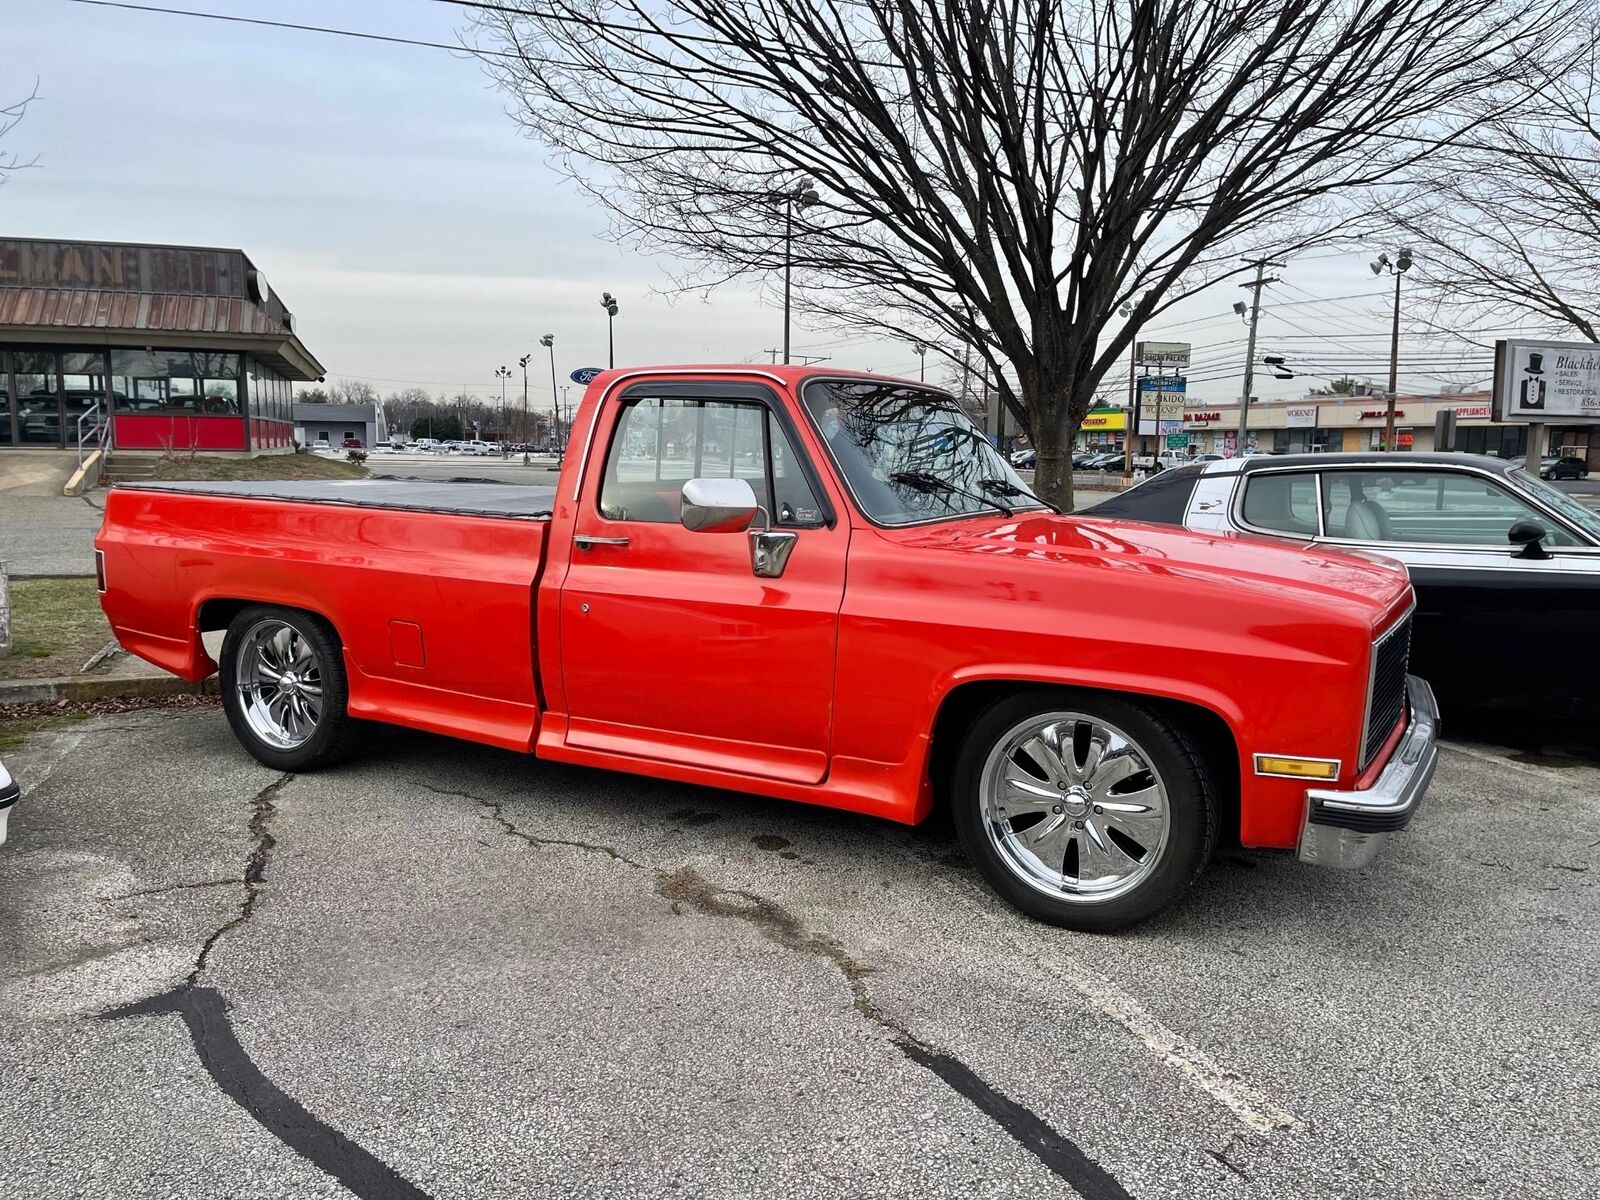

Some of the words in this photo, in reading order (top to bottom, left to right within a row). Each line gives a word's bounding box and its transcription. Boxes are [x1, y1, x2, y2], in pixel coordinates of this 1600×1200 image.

[1165, 354, 1188, 362] PALACE
[1557, 388, 1597, 396] RESTORATION
[1154, 394, 1185, 403] AIKIDO
[1145, 406, 1178, 414] WOKNET
[1456, 407, 1487, 416] APPLIANCE
[1194, 413, 1221, 422] BAZAAR
